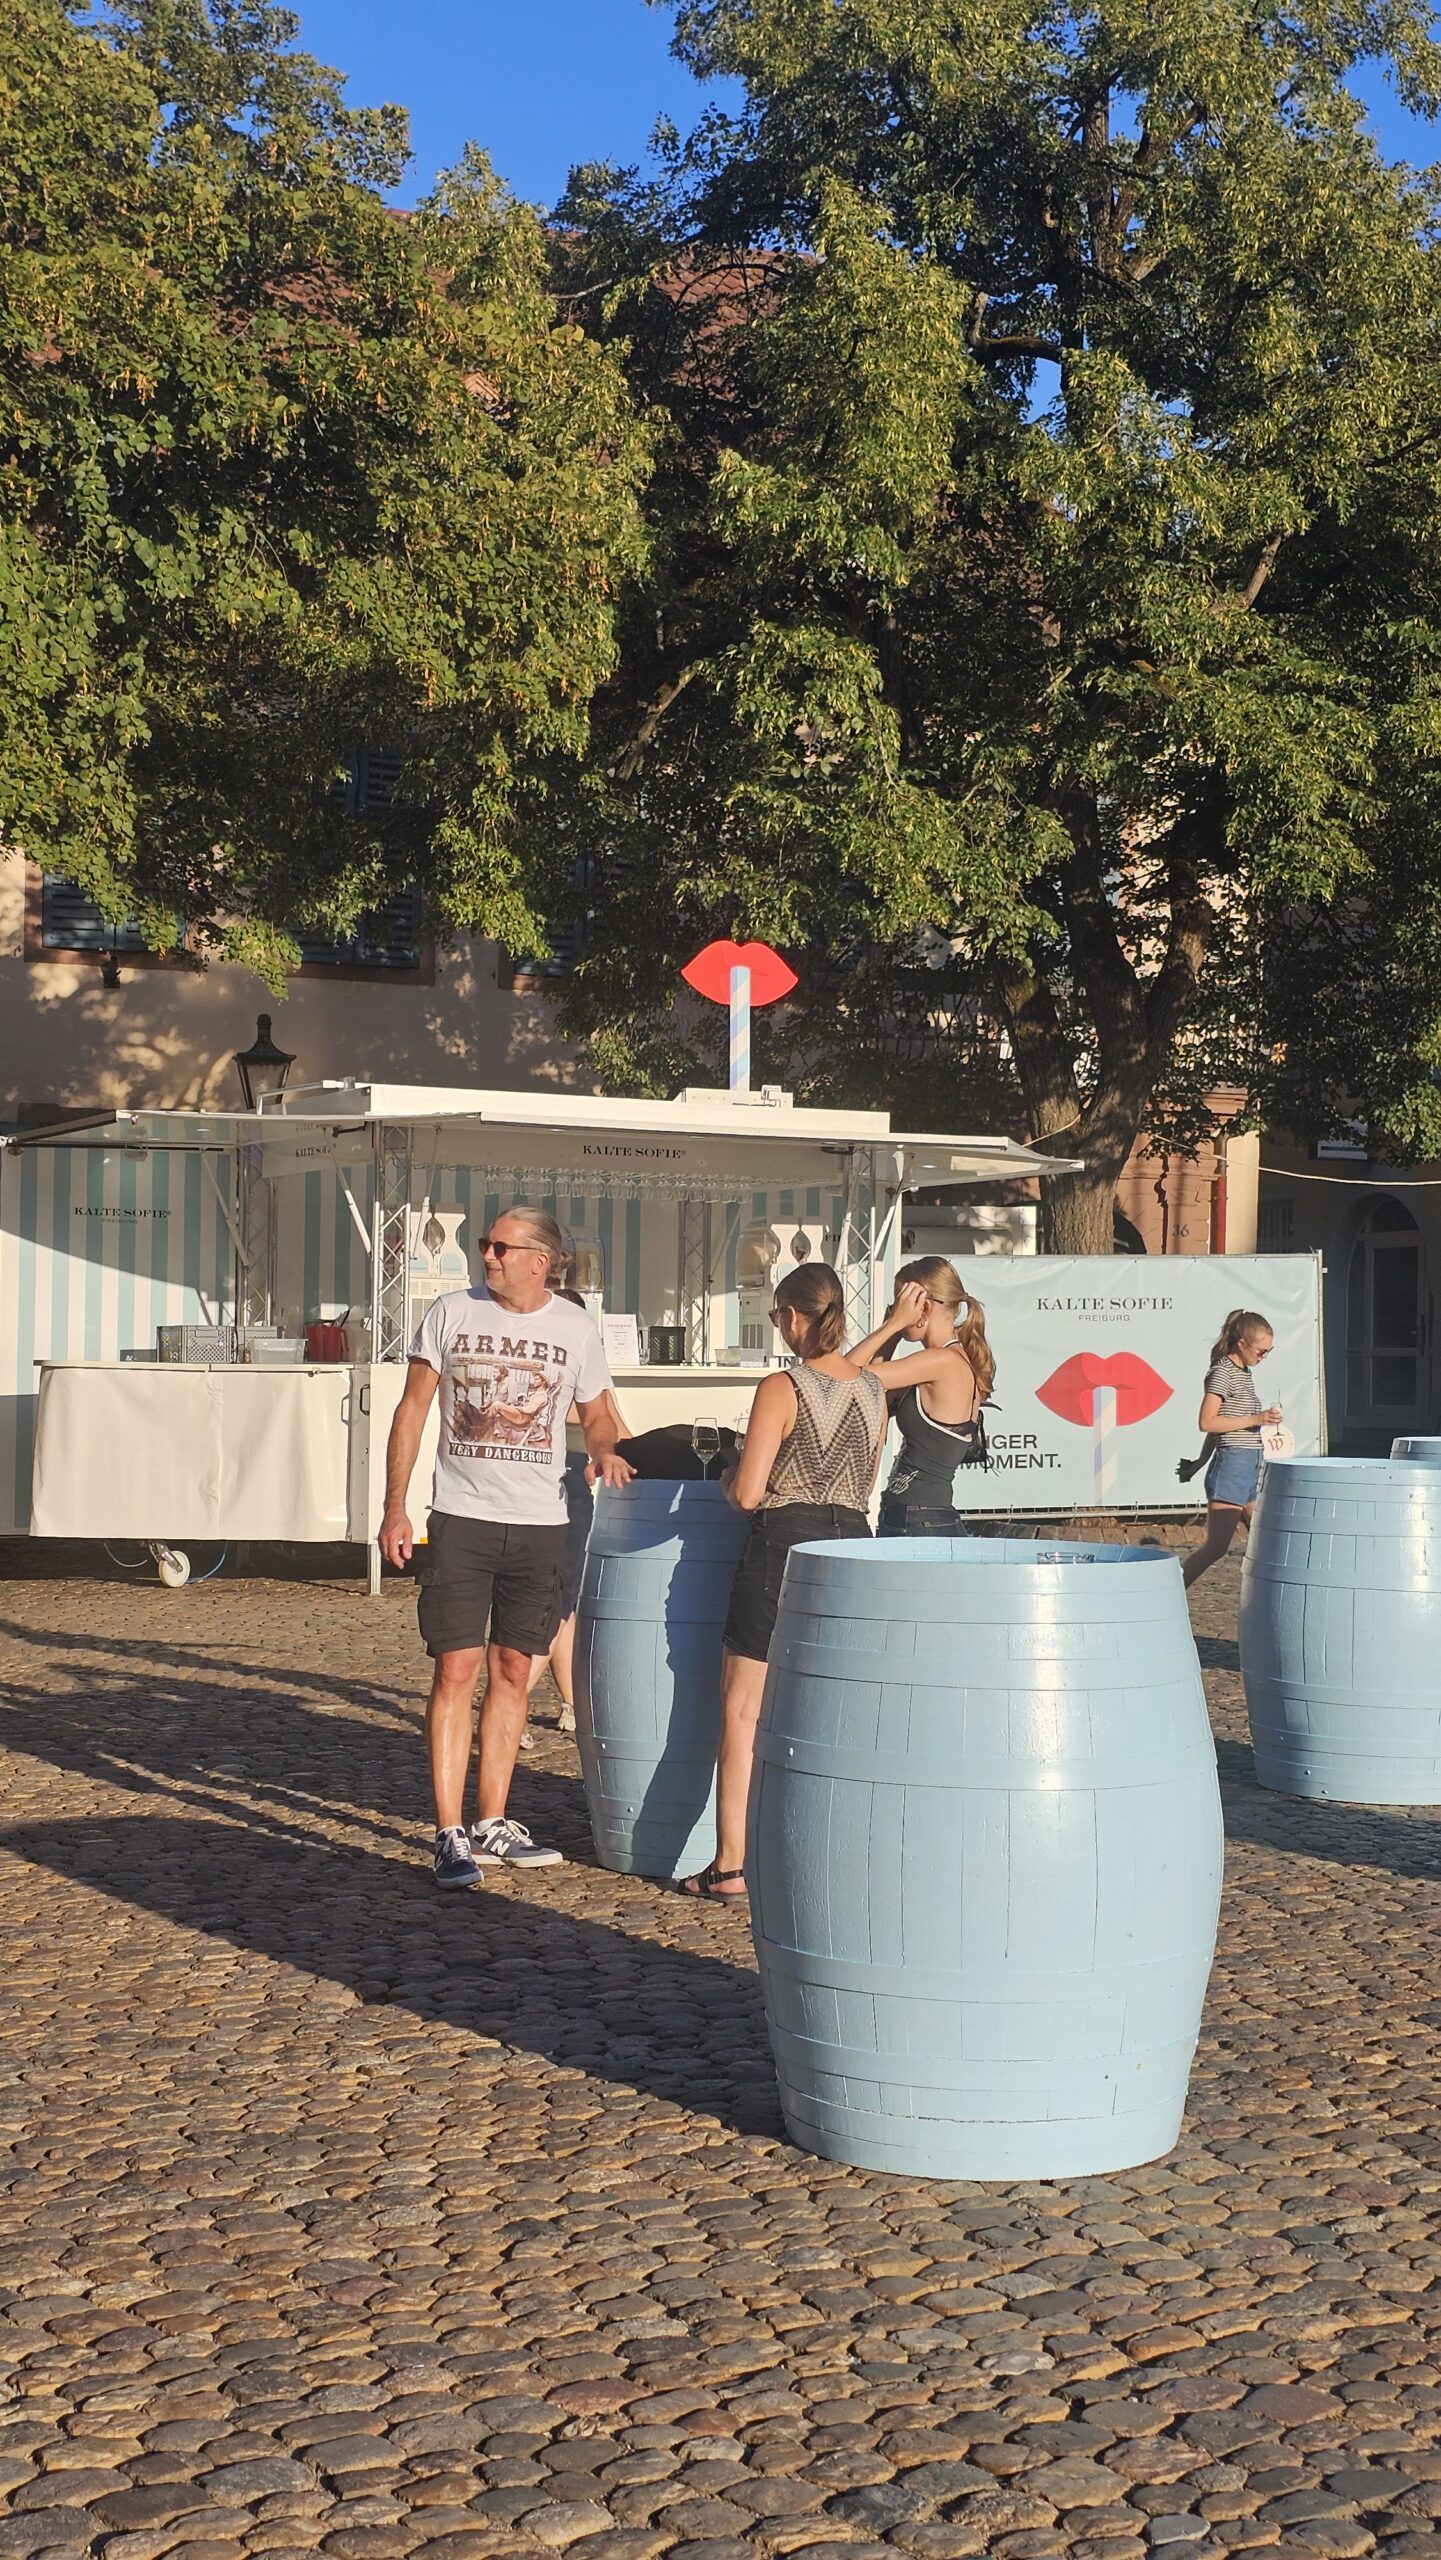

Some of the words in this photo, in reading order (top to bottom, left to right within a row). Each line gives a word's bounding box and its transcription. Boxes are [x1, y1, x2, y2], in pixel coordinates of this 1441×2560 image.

[583, 1145, 632, 1157] KALTE
[74, 1207, 120, 1217] KALTE
[1172, 1224, 1189, 1238] 36
[1036, 1298, 1104, 1310] KALTE
[1109, 1298, 1173, 1310] SOFIE
[1078, 1314, 1131, 1322] FREIBURG
[451, 1334, 568, 1367] ARMED
[985, 1434, 1038, 1450] GER
[450, 1443, 478, 1457] VERY
[484, 1445, 552, 1463] DANGEROUS
